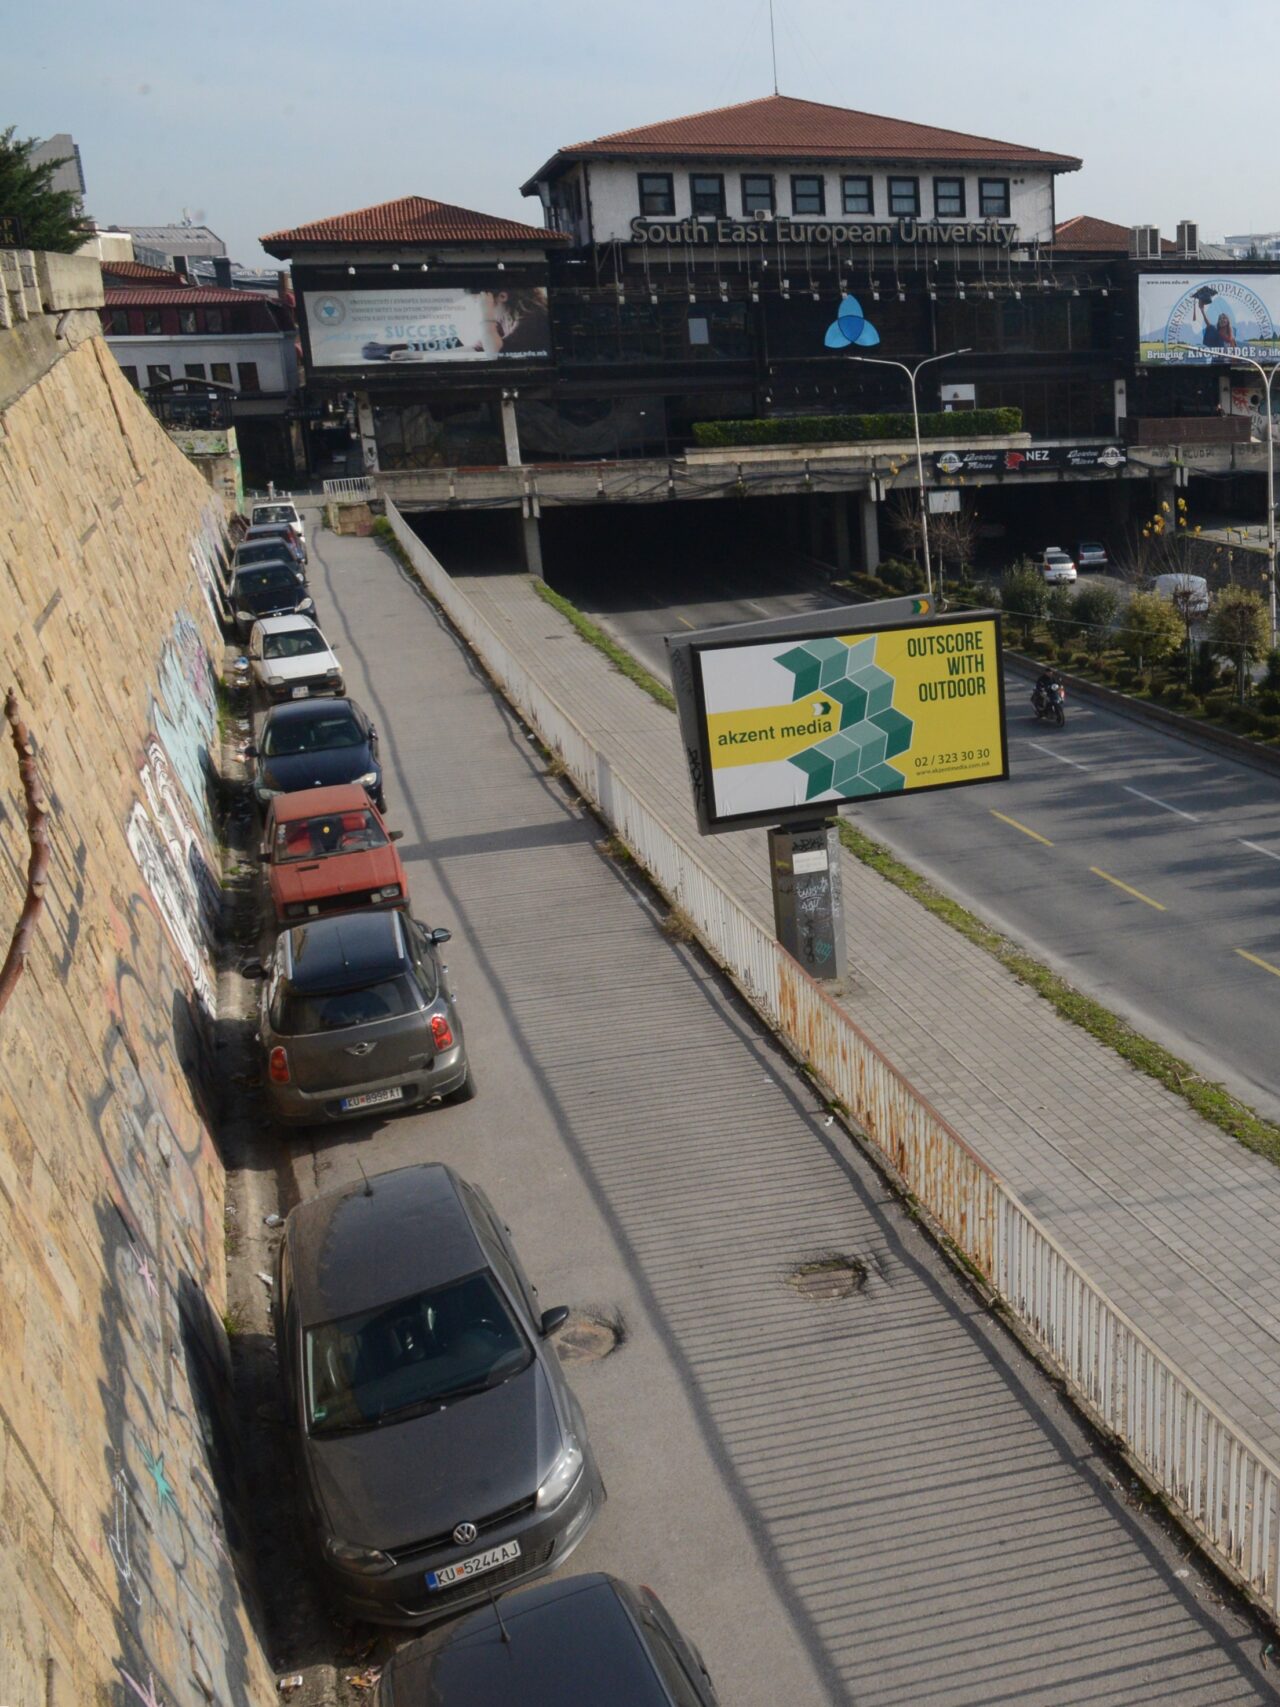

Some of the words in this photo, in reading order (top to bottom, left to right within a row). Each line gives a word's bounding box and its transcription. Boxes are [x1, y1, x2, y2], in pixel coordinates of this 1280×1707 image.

[632, 218, 709, 243] South
[717, 219, 769, 243] East
[776, 219, 892, 248] European
[899, 218, 1016, 248] University
[384, 324, 459, 338] SUCCESS
[407, 337, 459, 351] STORY
[1147, 350, 1184, 361] Bringing
[1188, 347, 1256, 358] KNOWLEDGE
[1026, 450, 1049, 461] NEZ
[907, 631, 983, 657] OUTSCORE
[946, 654, 985, 677] WITH
[918, 676, 986, 702] OUTDOOR
[717, 724, 776, 746] akzent
[781, 719, 833, 739] media
[914, 757, 928, 768] 02
[937, 752, 958, 765] 323
[961, 750, 974, 762] 30
[976, 748, 990, 759] 30
[436, 1567, 456, 1585] KU
[463, 1551, 499, 1575] 5244
[501, 1542, 519, 1560] AJ
